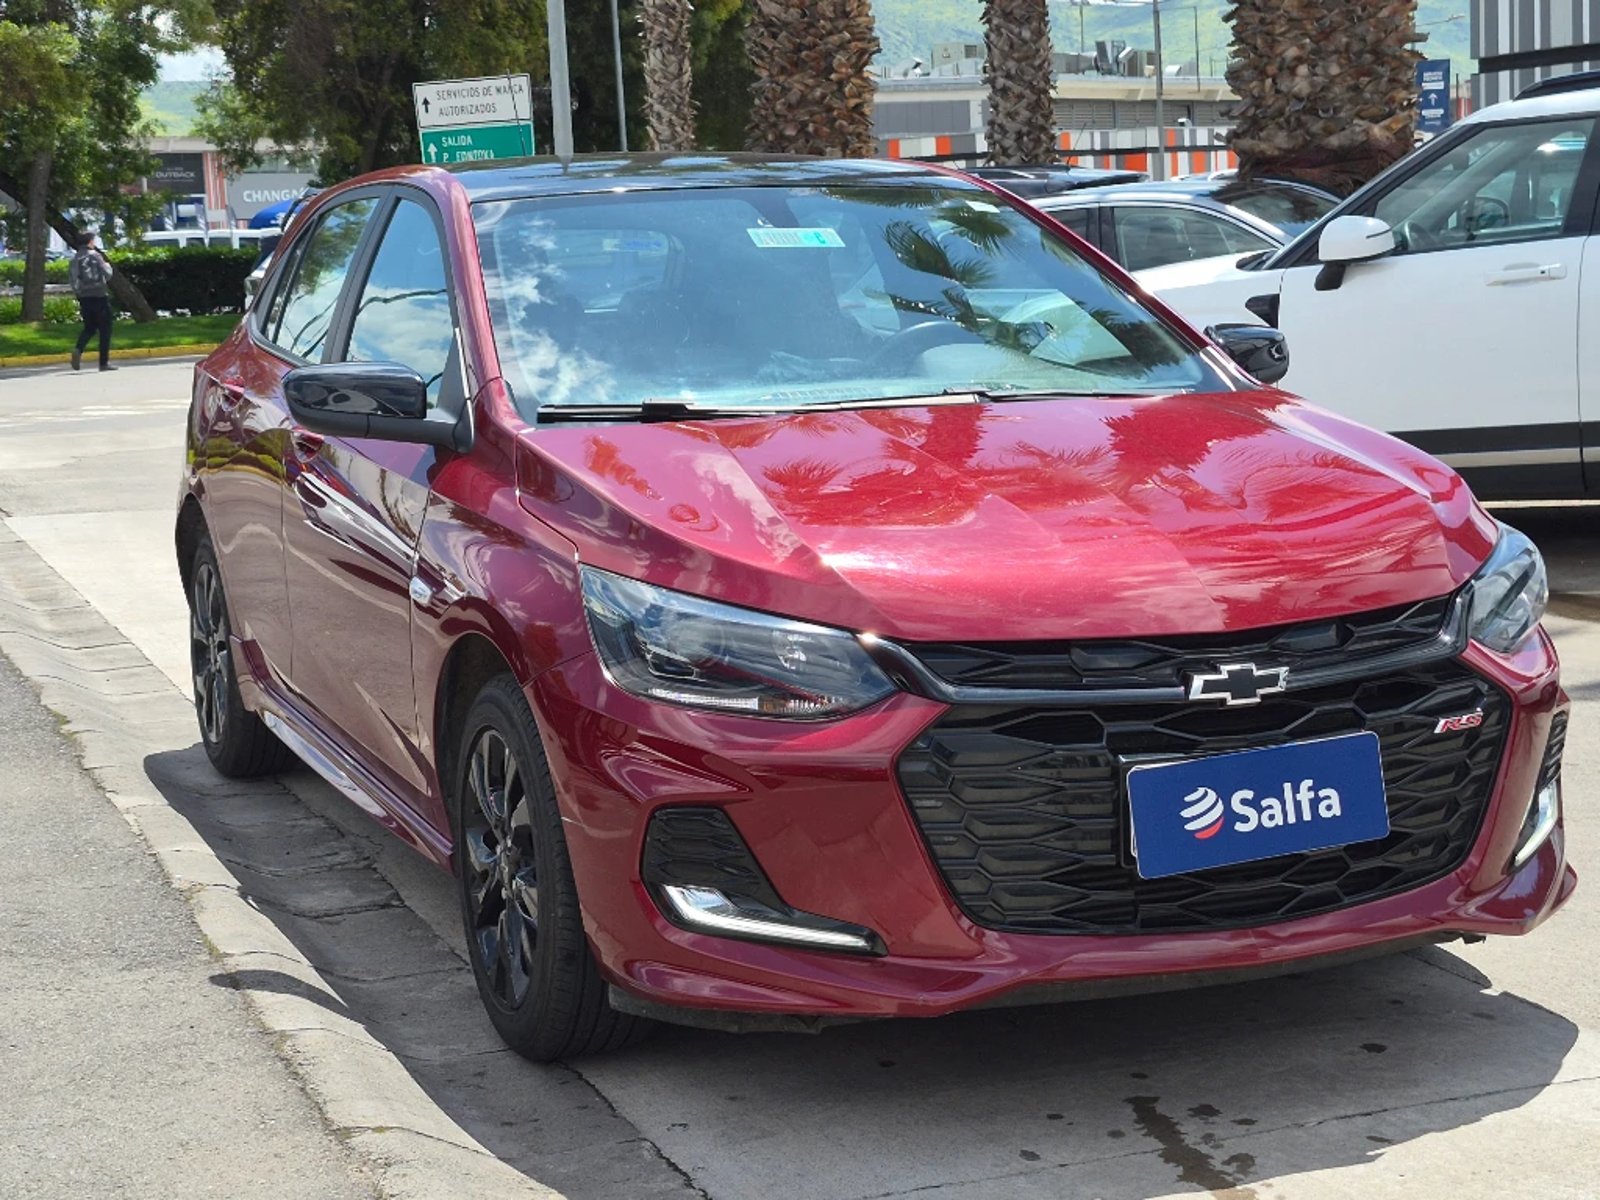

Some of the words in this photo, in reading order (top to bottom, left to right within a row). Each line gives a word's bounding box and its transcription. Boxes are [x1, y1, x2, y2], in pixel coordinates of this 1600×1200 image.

[436, 87, 480, 101] SERVICIOS
[482, 85, 493, 97] DE
[495, 83, 524, 96] MARCA
[439, 103, 498, 117] AUTORIZADOS
[441, 135, 473, 148] SALIDA
[243, 187, 304, 202] CHANGA
[1434, 707, 1484, 734] RS
[1230, 779, 1342, 832] Salfa
